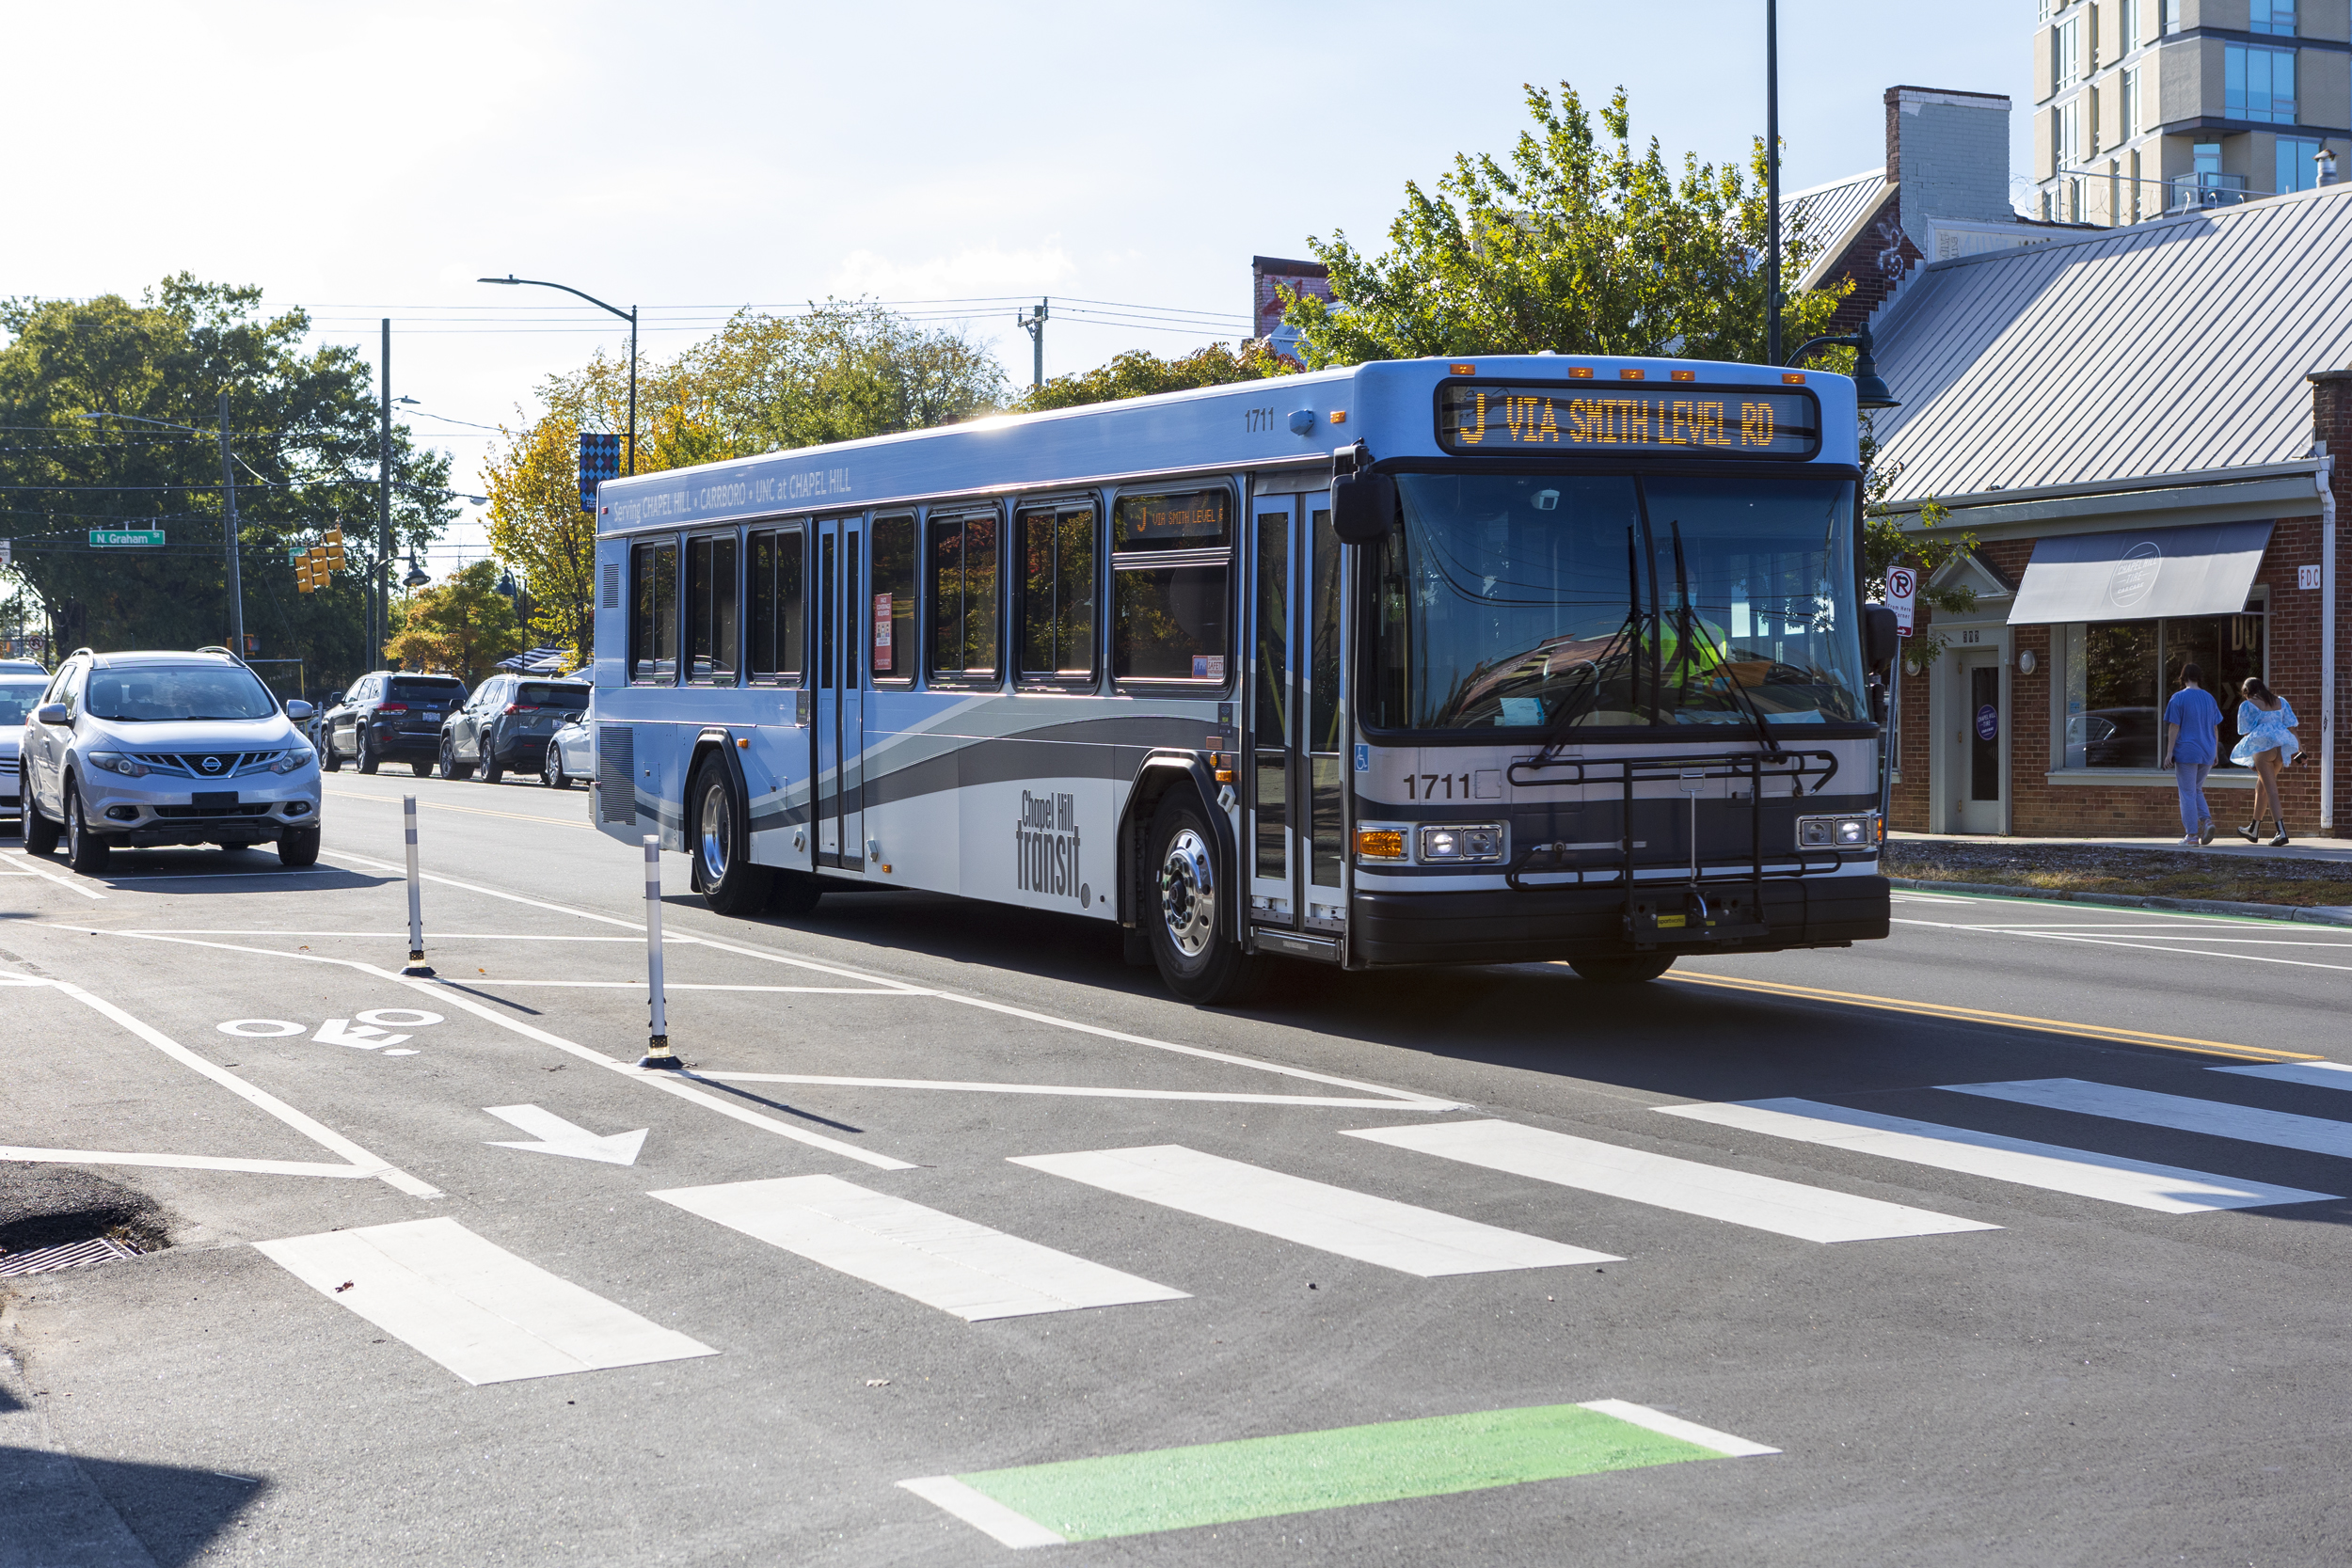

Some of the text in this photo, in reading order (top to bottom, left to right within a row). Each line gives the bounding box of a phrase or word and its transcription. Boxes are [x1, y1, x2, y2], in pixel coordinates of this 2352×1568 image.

[1245, 406, 1274, 433] 1711
[1459, 392, 1774, 447] J VIA SMITH LEVEL RD
[613, 467, 851, 524] Serving CHAPEL HILL CARRBORO UNC at CHAPEL HILL
[1136, 506, 1147, 532] J
[1152, 512, 1166, 526] VIA
[1168, 510, 1190, 525] SMITH
[1192, 509, 1216, 524] LEVEL
[97, 534, 107, 544] N.
[109, 533, 149, 545] Graham
[2118, 554, 2157, 575] CHAPEL HILL
[2126, 570, 2144, 583] TIRE
[1208, 661, 1224, 670] SAFETY
[1403, 773, 1470, 800] 1711
[1022, 789, 1073, 832] Chapel Hill
